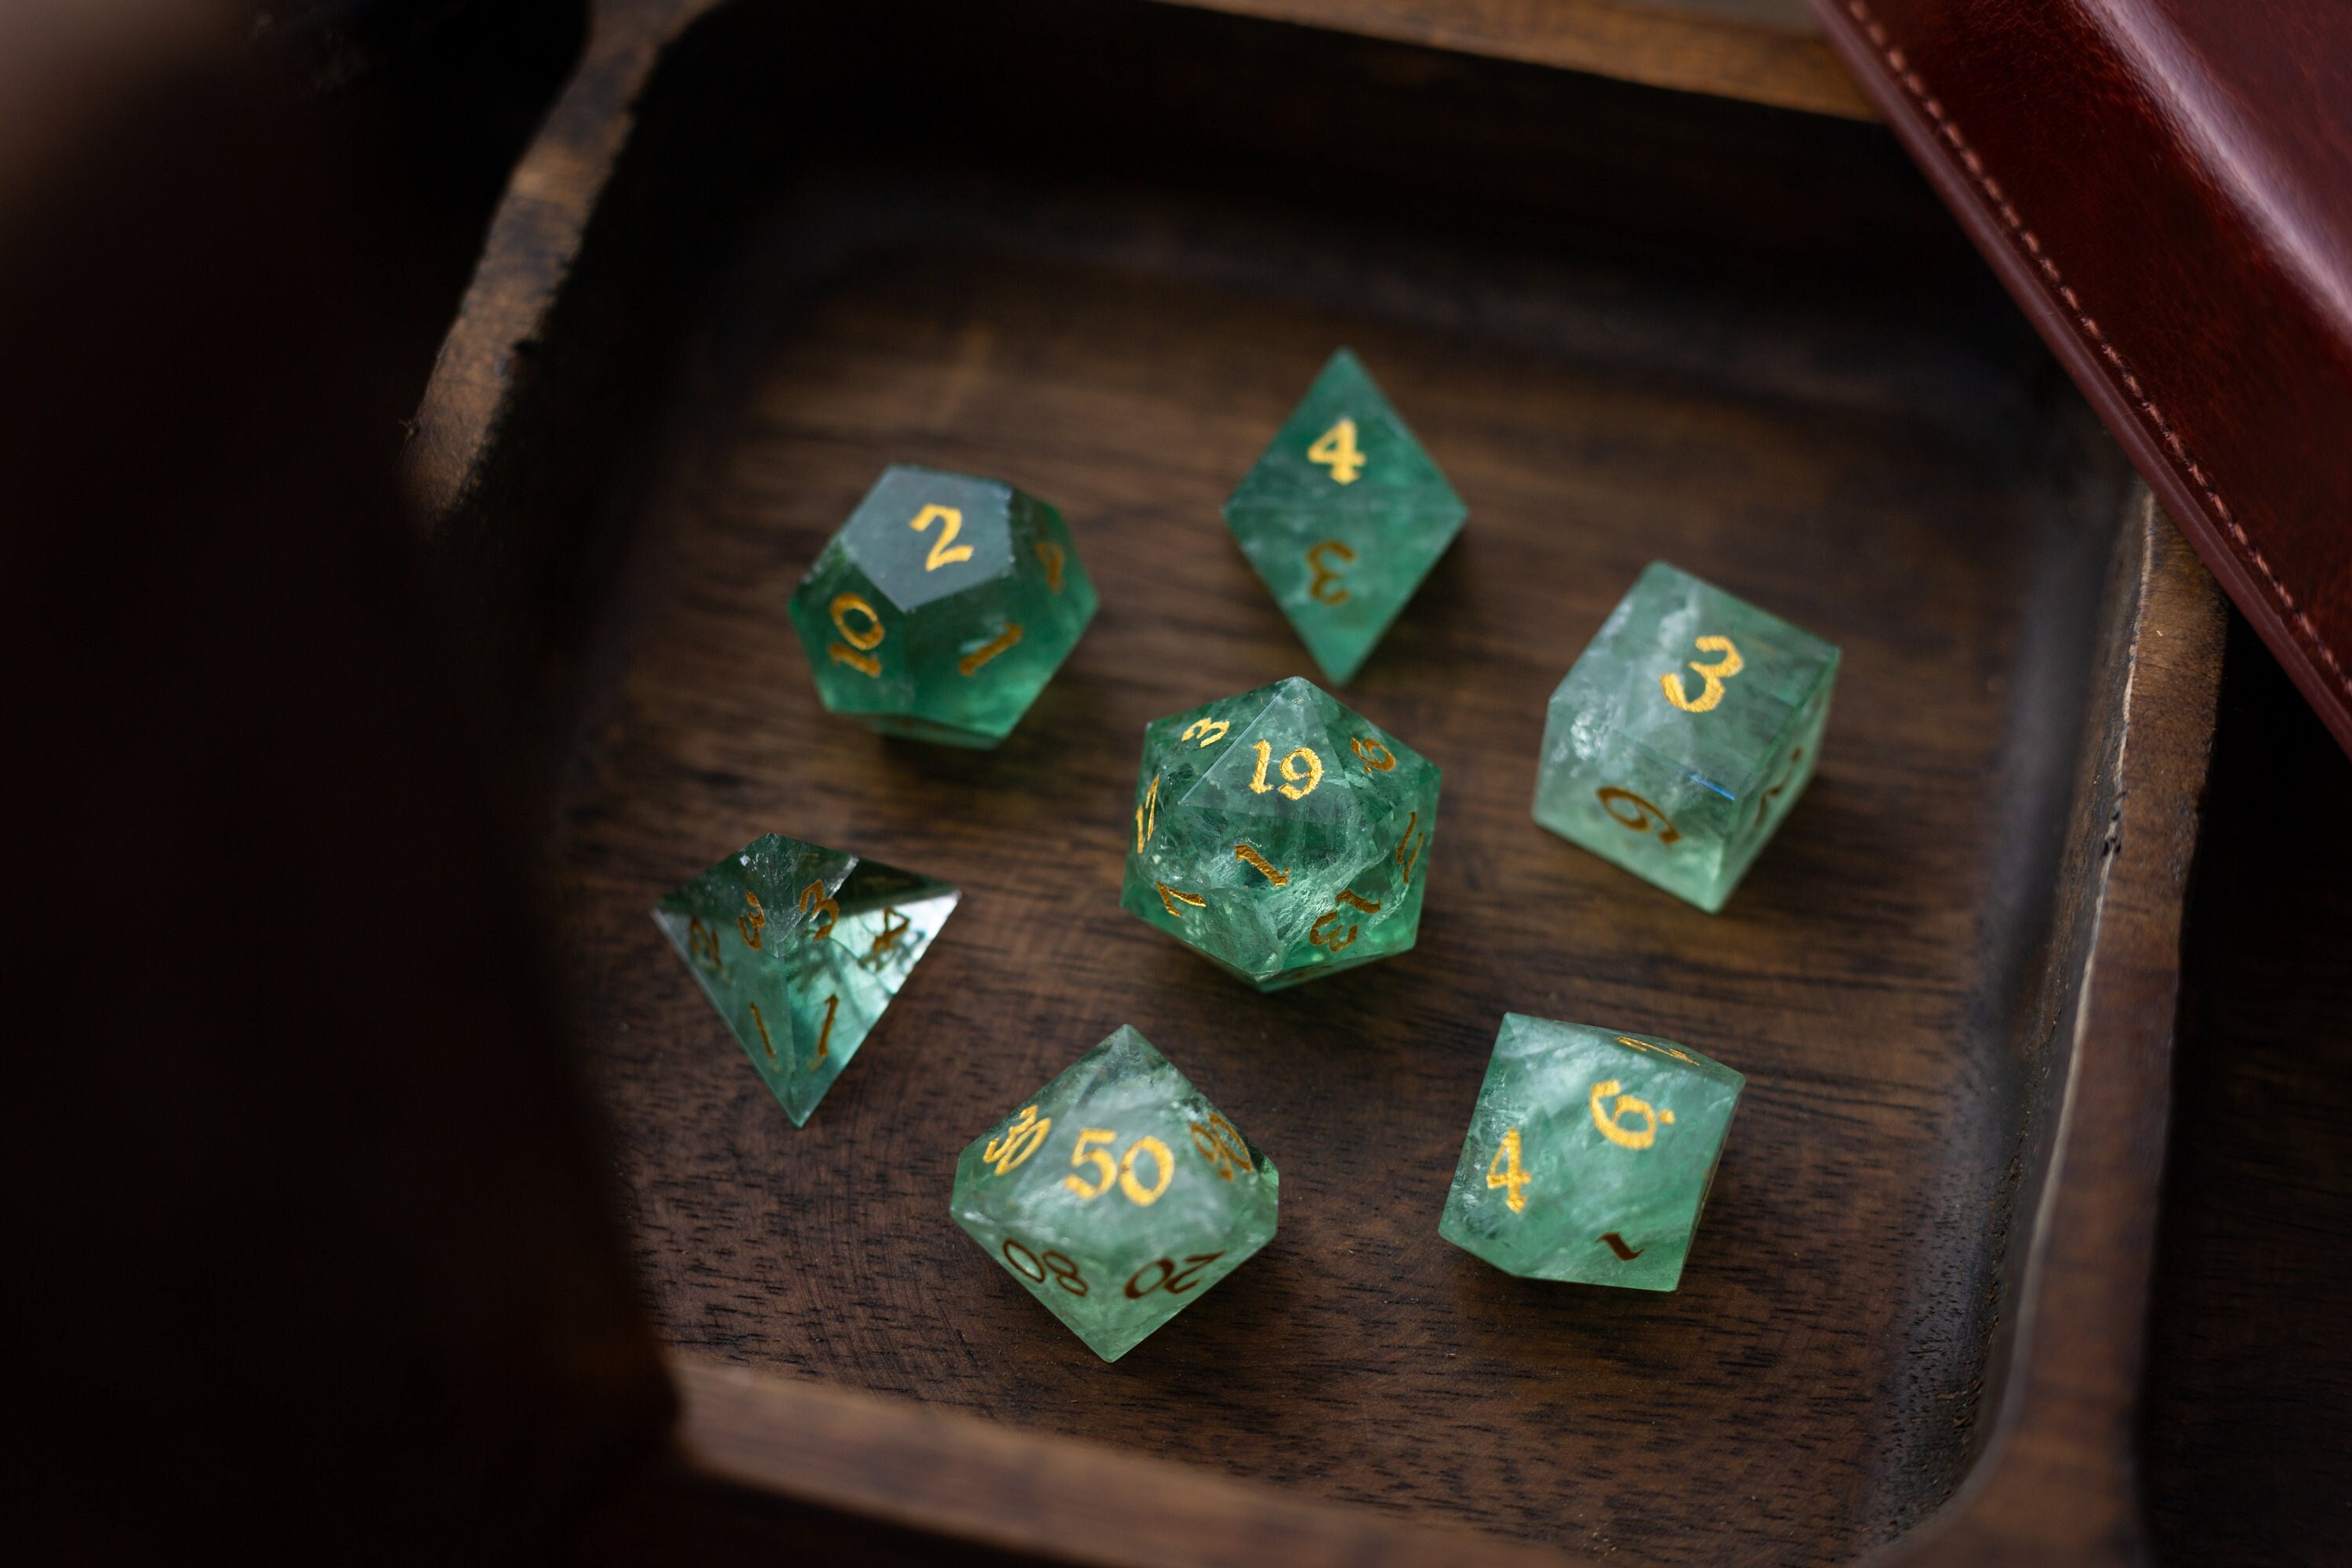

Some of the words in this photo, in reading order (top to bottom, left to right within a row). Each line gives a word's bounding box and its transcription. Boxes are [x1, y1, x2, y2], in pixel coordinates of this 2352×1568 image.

[1308, 418, 1366, 485] 4
[909, 503, 974, 572] 2
[1307, 540, 1356, 606] 3
[829, 593, 885, 677] 10
[1659, 637, 1744, 713] 3
[1181, 717, 1229, 747] 3
[1249, 739, 1324, 800] 19
[1235, 844, 1290, 887] 1
[738, 891, 765, 951] 3
[799, 879, 840, 941] 3
[1309, 889, 1381, 952] 13
[750, 1002, 775, 1058] 1
[819, 994, 839, 1058] 1
[982, 1105, 1051, 1176] 30
[1063, 1128, 1174, 1207] 50
[1190, 1112, 1254, 1181] 90
[1486, 1126, 1532, 1214] 4
[1003, 1238, 1089, 1297] 80
[1124, 1250, 1226, 1298] 20
